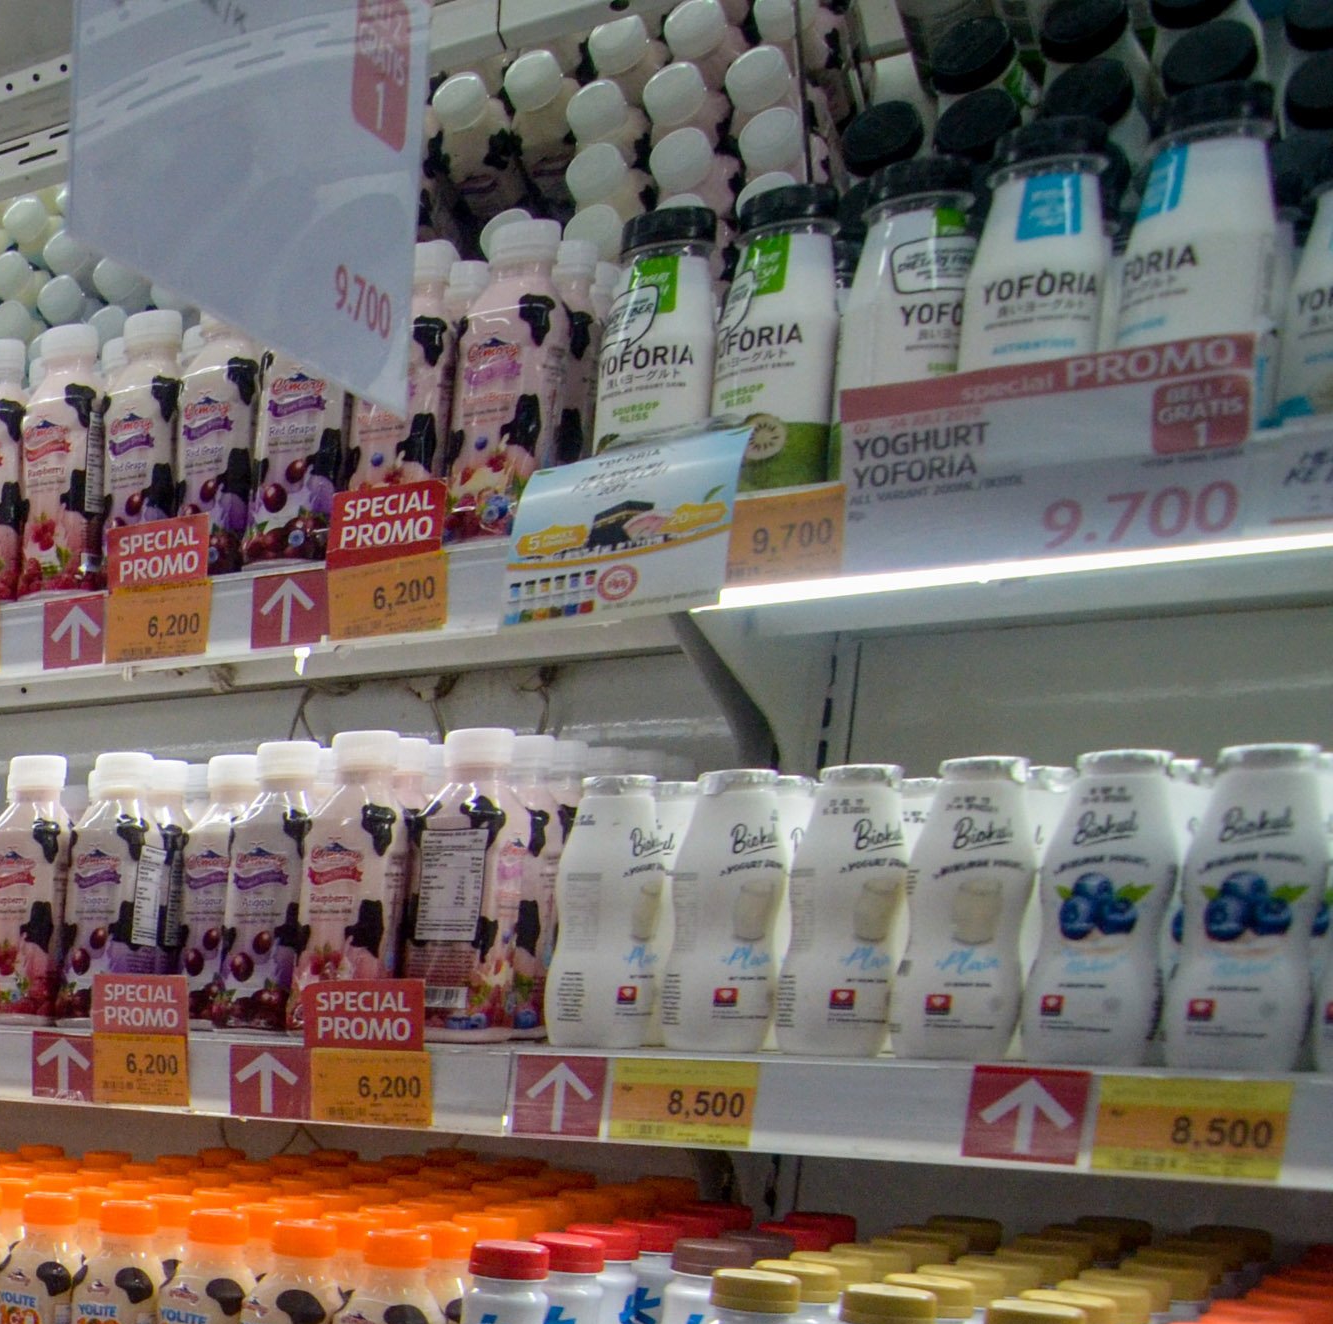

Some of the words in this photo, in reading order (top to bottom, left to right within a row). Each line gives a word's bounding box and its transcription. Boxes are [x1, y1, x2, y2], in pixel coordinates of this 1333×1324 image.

[335, 264, 391, 339] 9.700
[1066, 339, 1234, 388] PROMO
[1158, 398, 1244, 424] GRATIS
[853, 422, 991, 461] YOGHURT
[342, 489, 435, 522] SPECIAL
[1043, 480, 1239, 550] 9.700
[118, 527, 198, 557] SPECIAL
[340, 517, 434, 550] PROMO
[753, 517, 833, 554] 9,700
[119, 551, 198, 583] PROMO
[373, 576, 436, 610] 6,200
[147, 612, 200, 638] 6,200
[104, 983, 177, 1003] SPECIAL
[316, 991, 412, 1012] SPECIAL
[103, 1007, 179, 1028] PROMO
[317, 1017, 411, 1042] PROMO
[126, 1053, 178, 1077] 6,200
[358, 1076, 421, 1099] 6,200
[667, 1089, 744, 1119] 8,500
[78, 1303, 117, 1319] YOLITE
